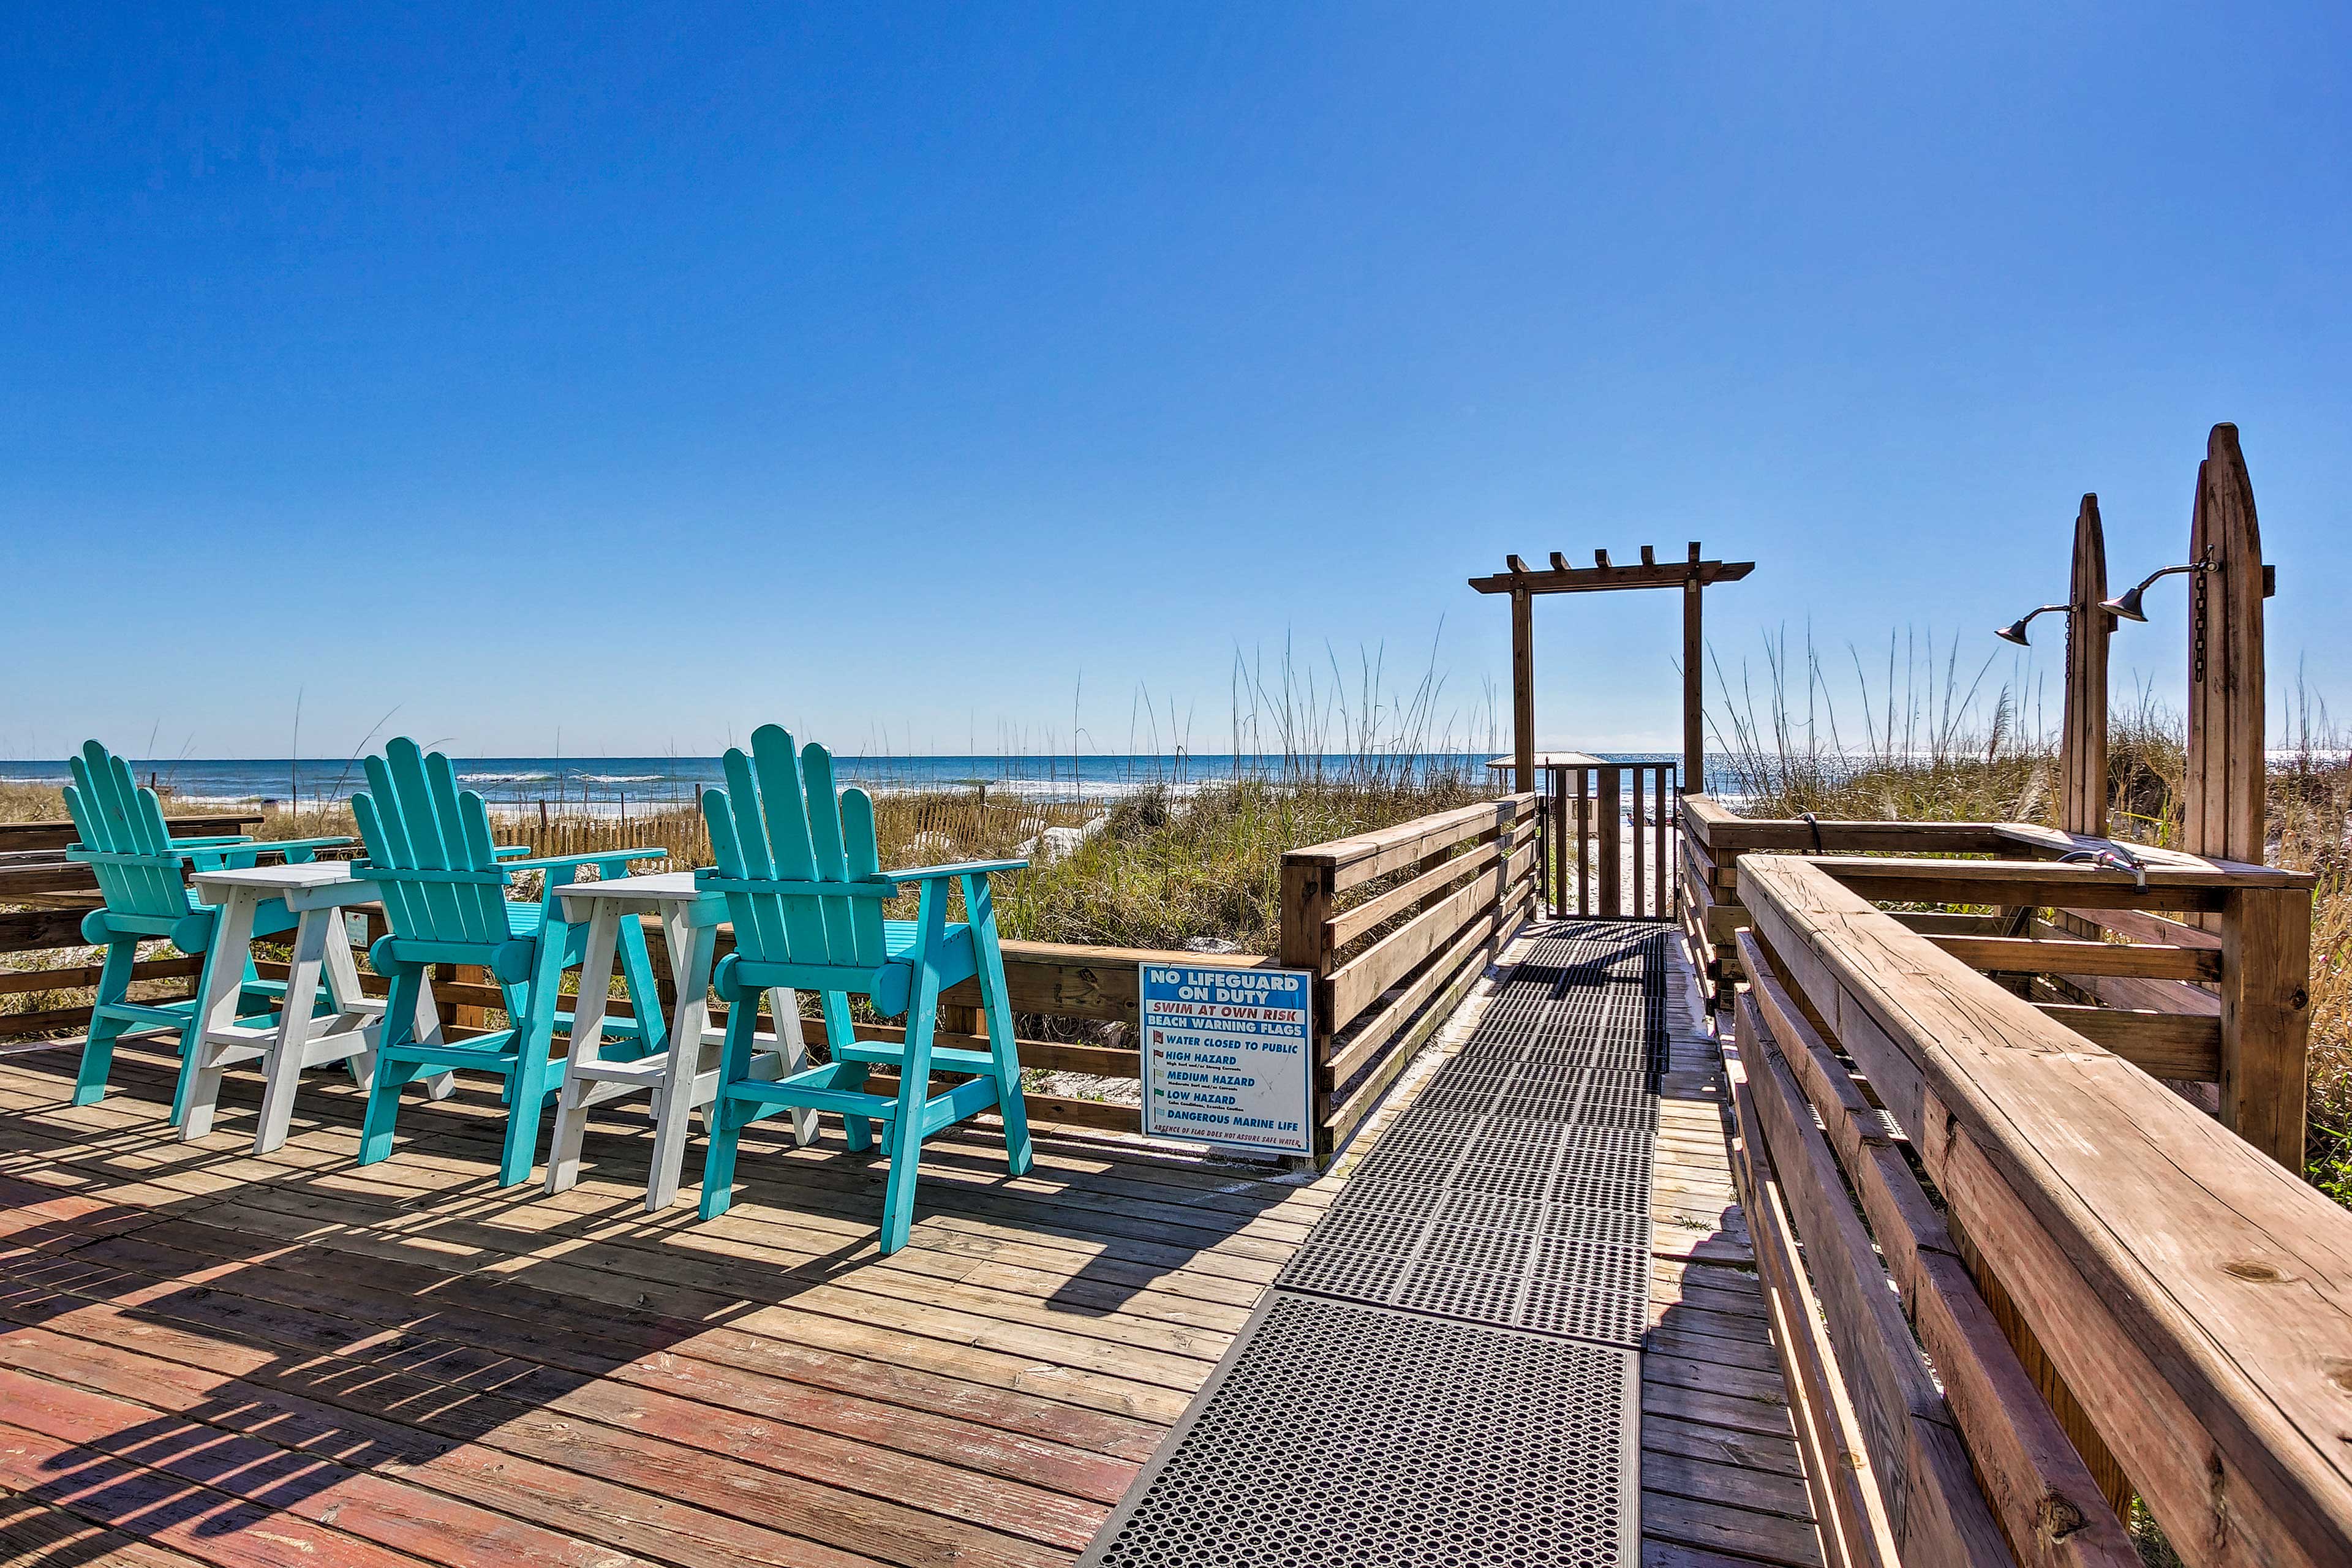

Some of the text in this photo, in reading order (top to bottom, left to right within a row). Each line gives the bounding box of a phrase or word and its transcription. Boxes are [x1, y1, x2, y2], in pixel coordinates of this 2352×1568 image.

[1150, 970, 1299, 991] NO LIFEGUARD
[1178, 987, 1270, 1005] ON DUTY
[1153, 1002, 1297, 1022] SWIM AT OWN RISK
[1148, 1015, 1302, 1036] BEACH WARNING FLAGS
[1166, 1035, 1298, 1054] WATER CLOSED TO PUBLIC
[1166, 1051, 1237, 1065] HIGH HAZARD
[1167, 1071, 1255, 1087] MEDIUM HAZARD
[1167, 1090, 1235, 1105] LOW HAZARD
[1167, 1110, 1298, 1131] DANGEROUS MARINE LIFE
